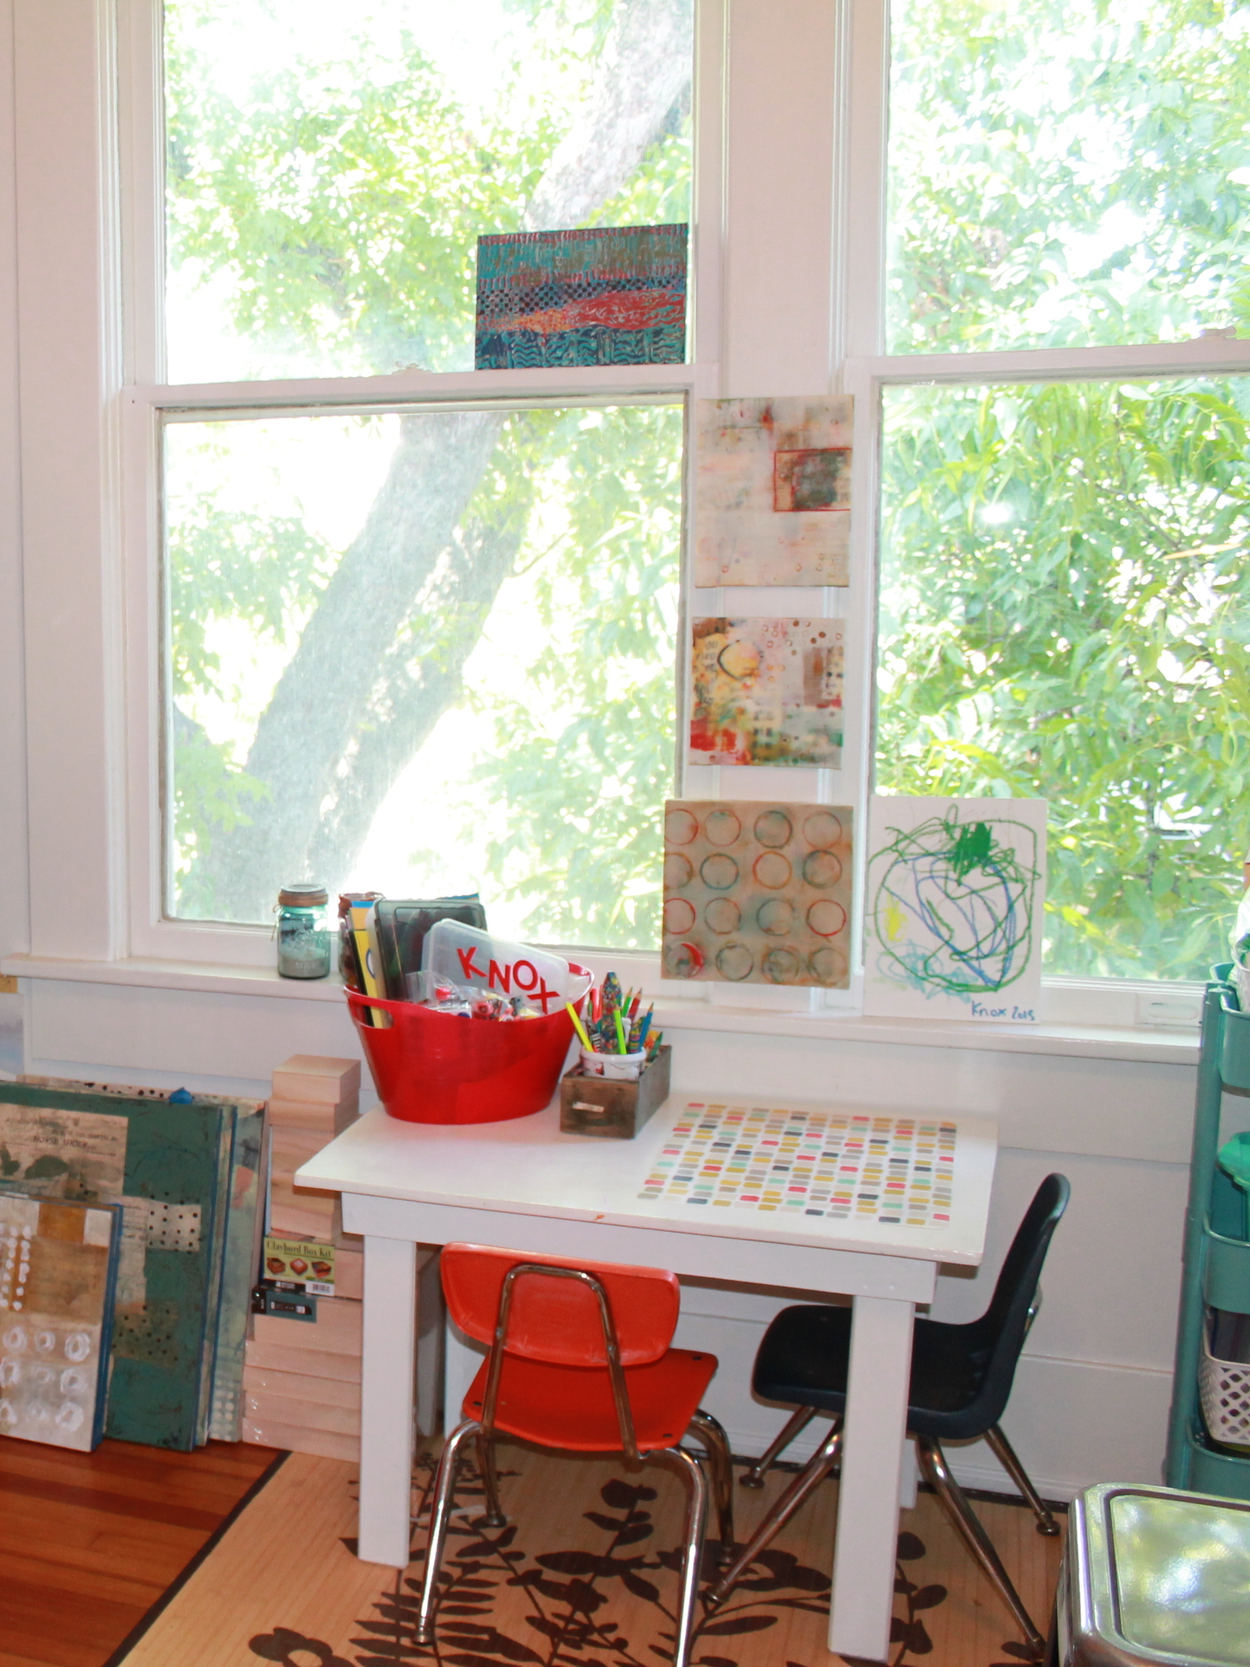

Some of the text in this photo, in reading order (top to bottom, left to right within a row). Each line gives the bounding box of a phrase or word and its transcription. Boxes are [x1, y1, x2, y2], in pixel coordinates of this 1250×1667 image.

[457, 946, 560, 1015] KNOX
[972, 1000, 1036, 1022] Knox 2015
[267, 1240, 331, 1258] Claybord Box Kit
